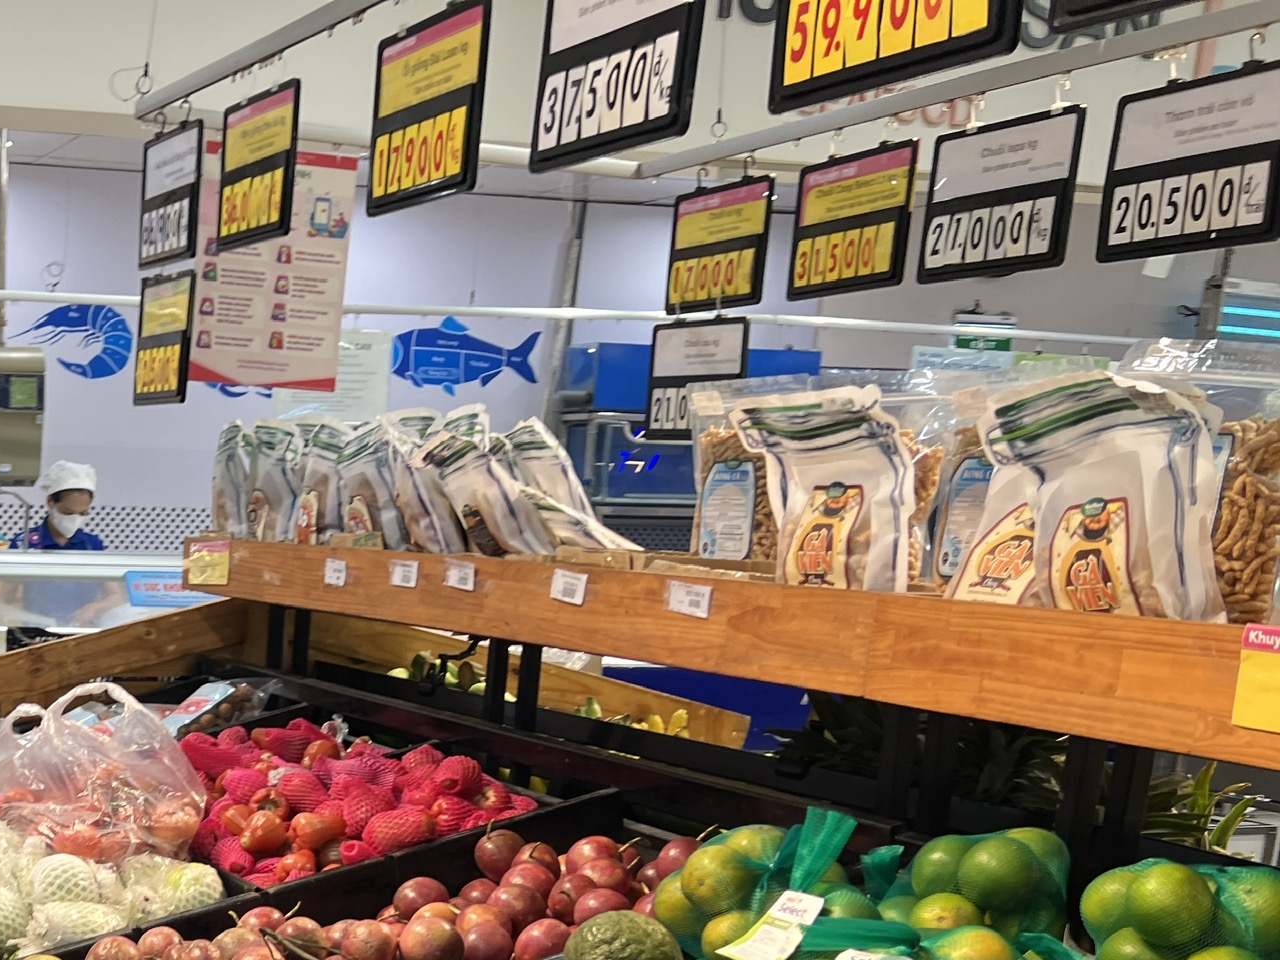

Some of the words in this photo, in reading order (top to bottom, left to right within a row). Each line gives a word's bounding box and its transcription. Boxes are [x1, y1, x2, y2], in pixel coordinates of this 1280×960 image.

[1114, 177, 1234, 235] 20.500
[653, 395, 688, 424] 21.0
[777, 902, 808, 918] Select
